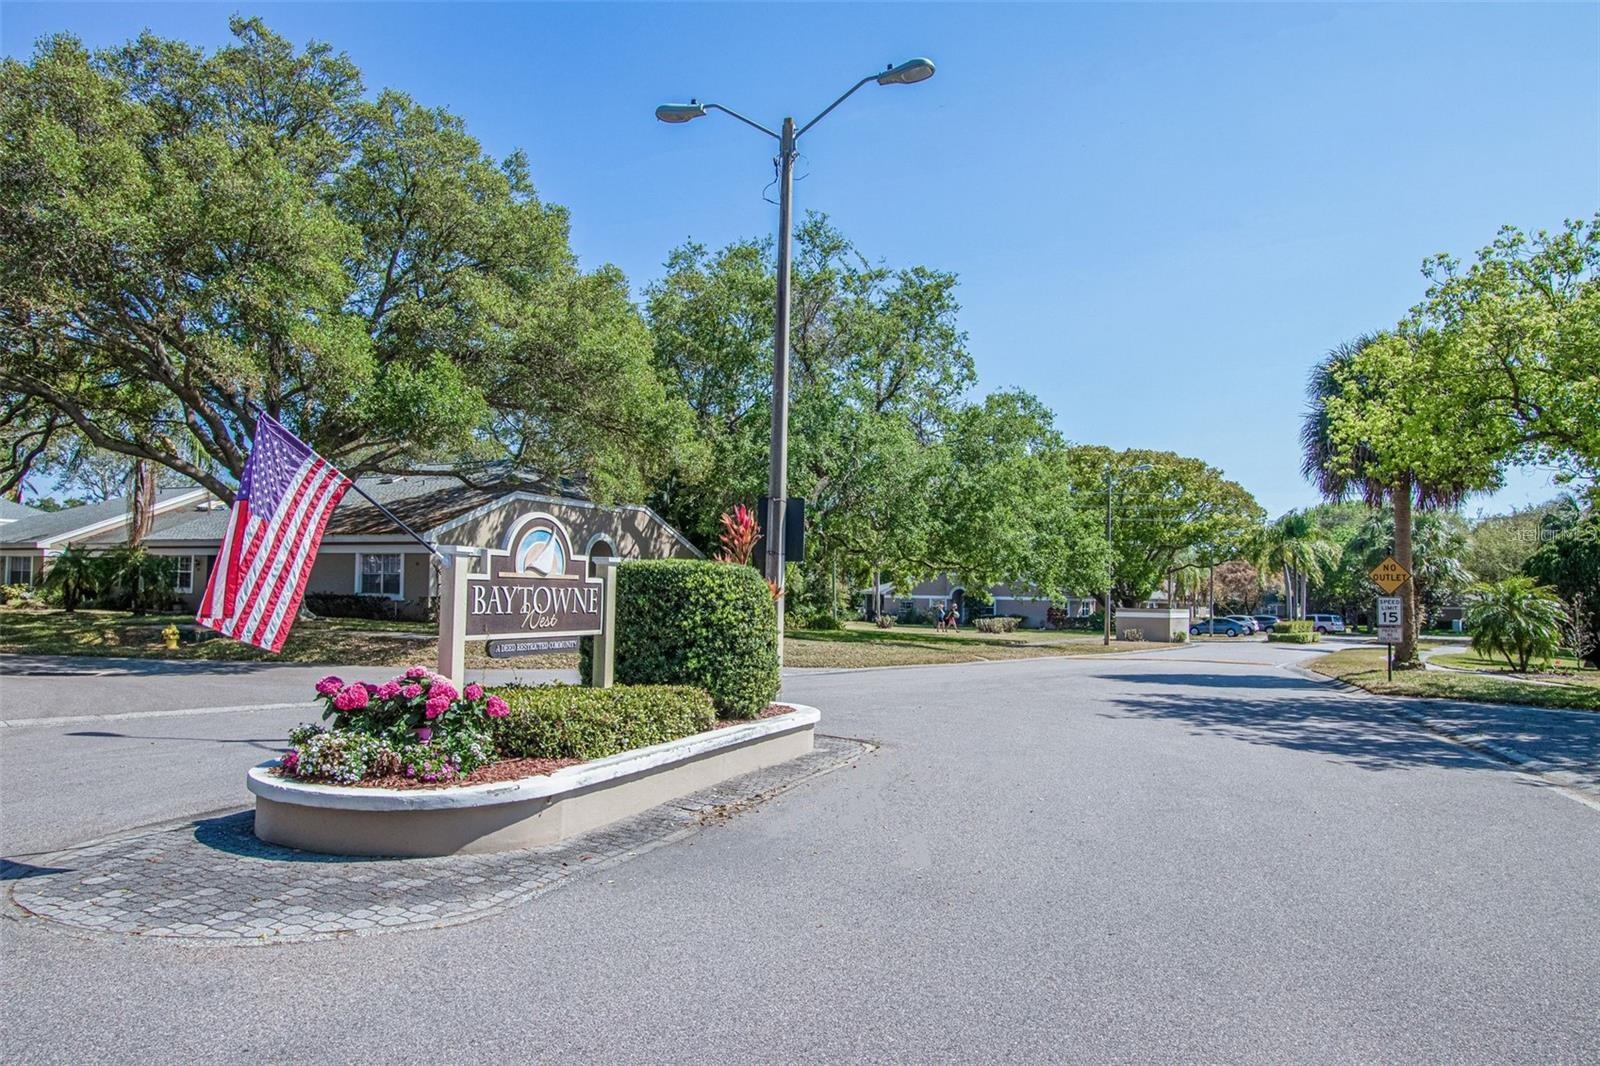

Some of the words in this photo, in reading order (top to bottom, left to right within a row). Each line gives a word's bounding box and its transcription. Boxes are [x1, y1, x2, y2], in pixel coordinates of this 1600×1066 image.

[1382, 564, 1397, 572] NO
[1373, 573, 1407, 581] OUTLET
[471, 584, 599, 615] BAYTOWNE
[520, 602, 558, 629] West
[1382, 612, 1398, 623] 15
[495, 645, 500, 653] A
